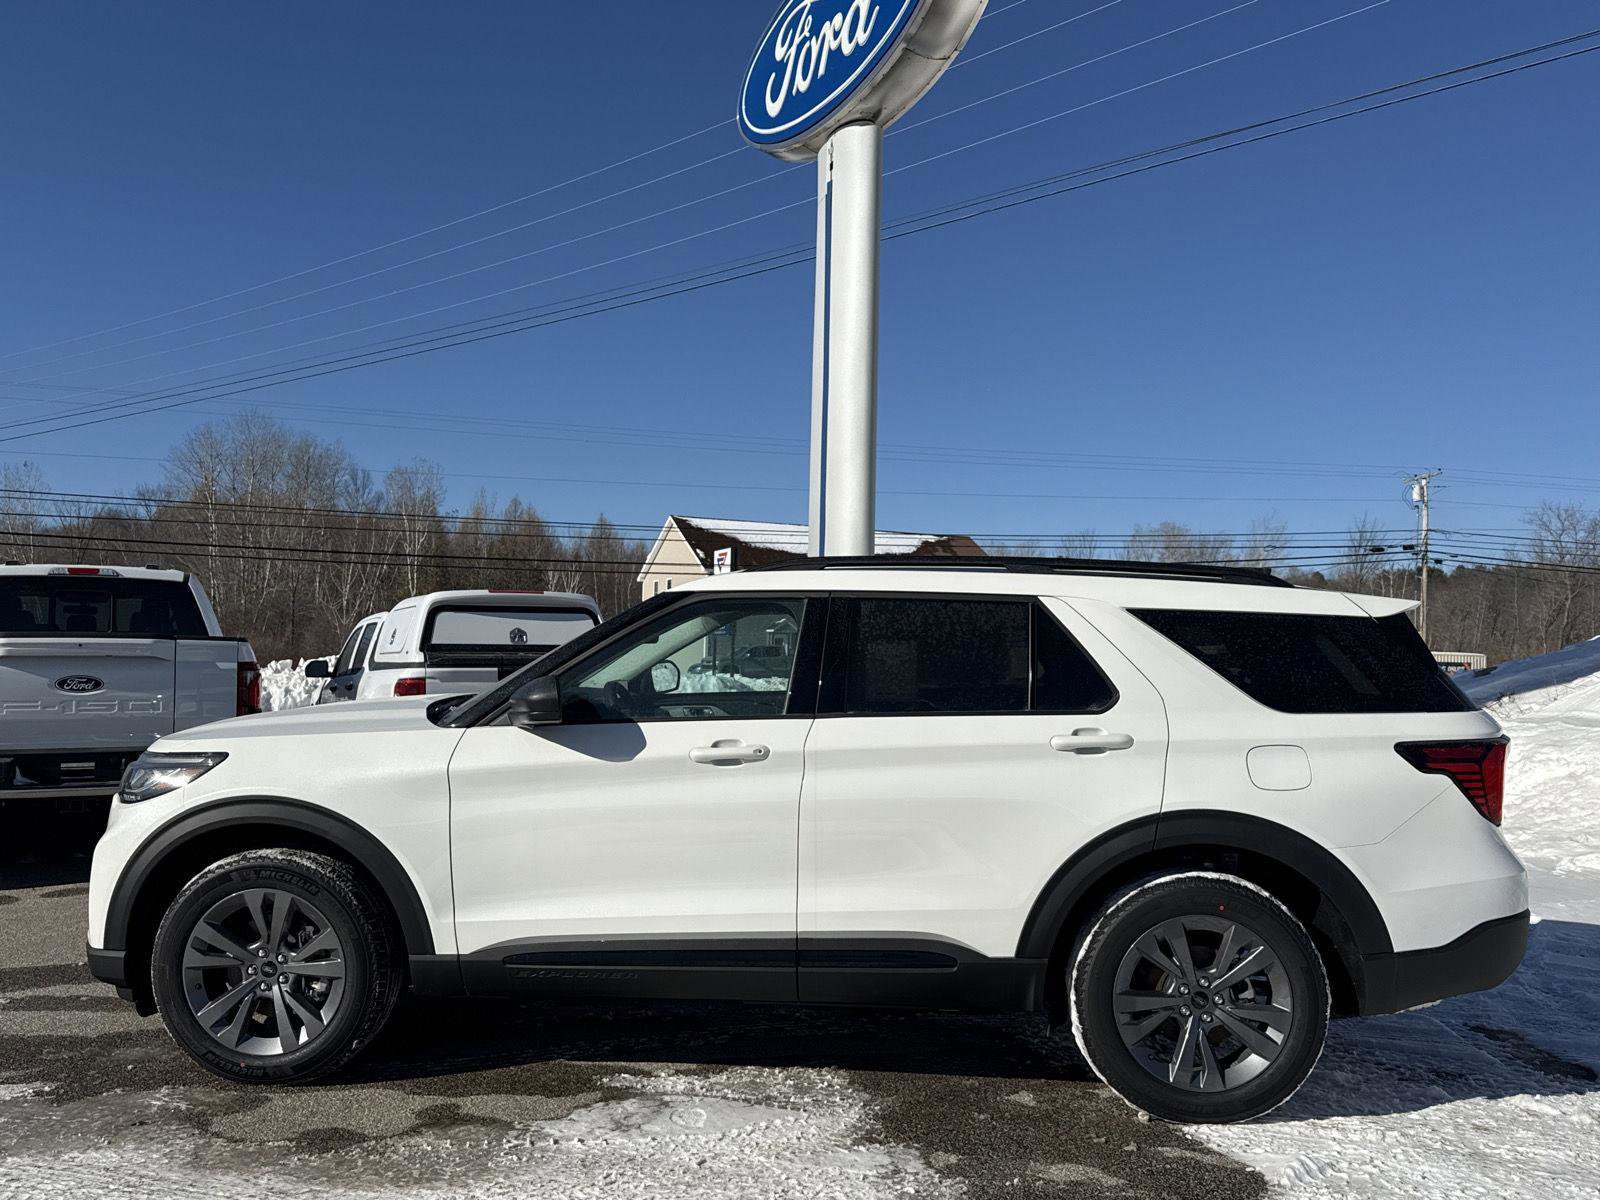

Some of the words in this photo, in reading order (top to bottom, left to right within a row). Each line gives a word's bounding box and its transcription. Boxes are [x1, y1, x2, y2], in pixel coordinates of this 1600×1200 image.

[765, 0, 879, 118] Ford
[64, 678, 95, 690] Ford
[258, 870, 320, 895] MICHELIN
